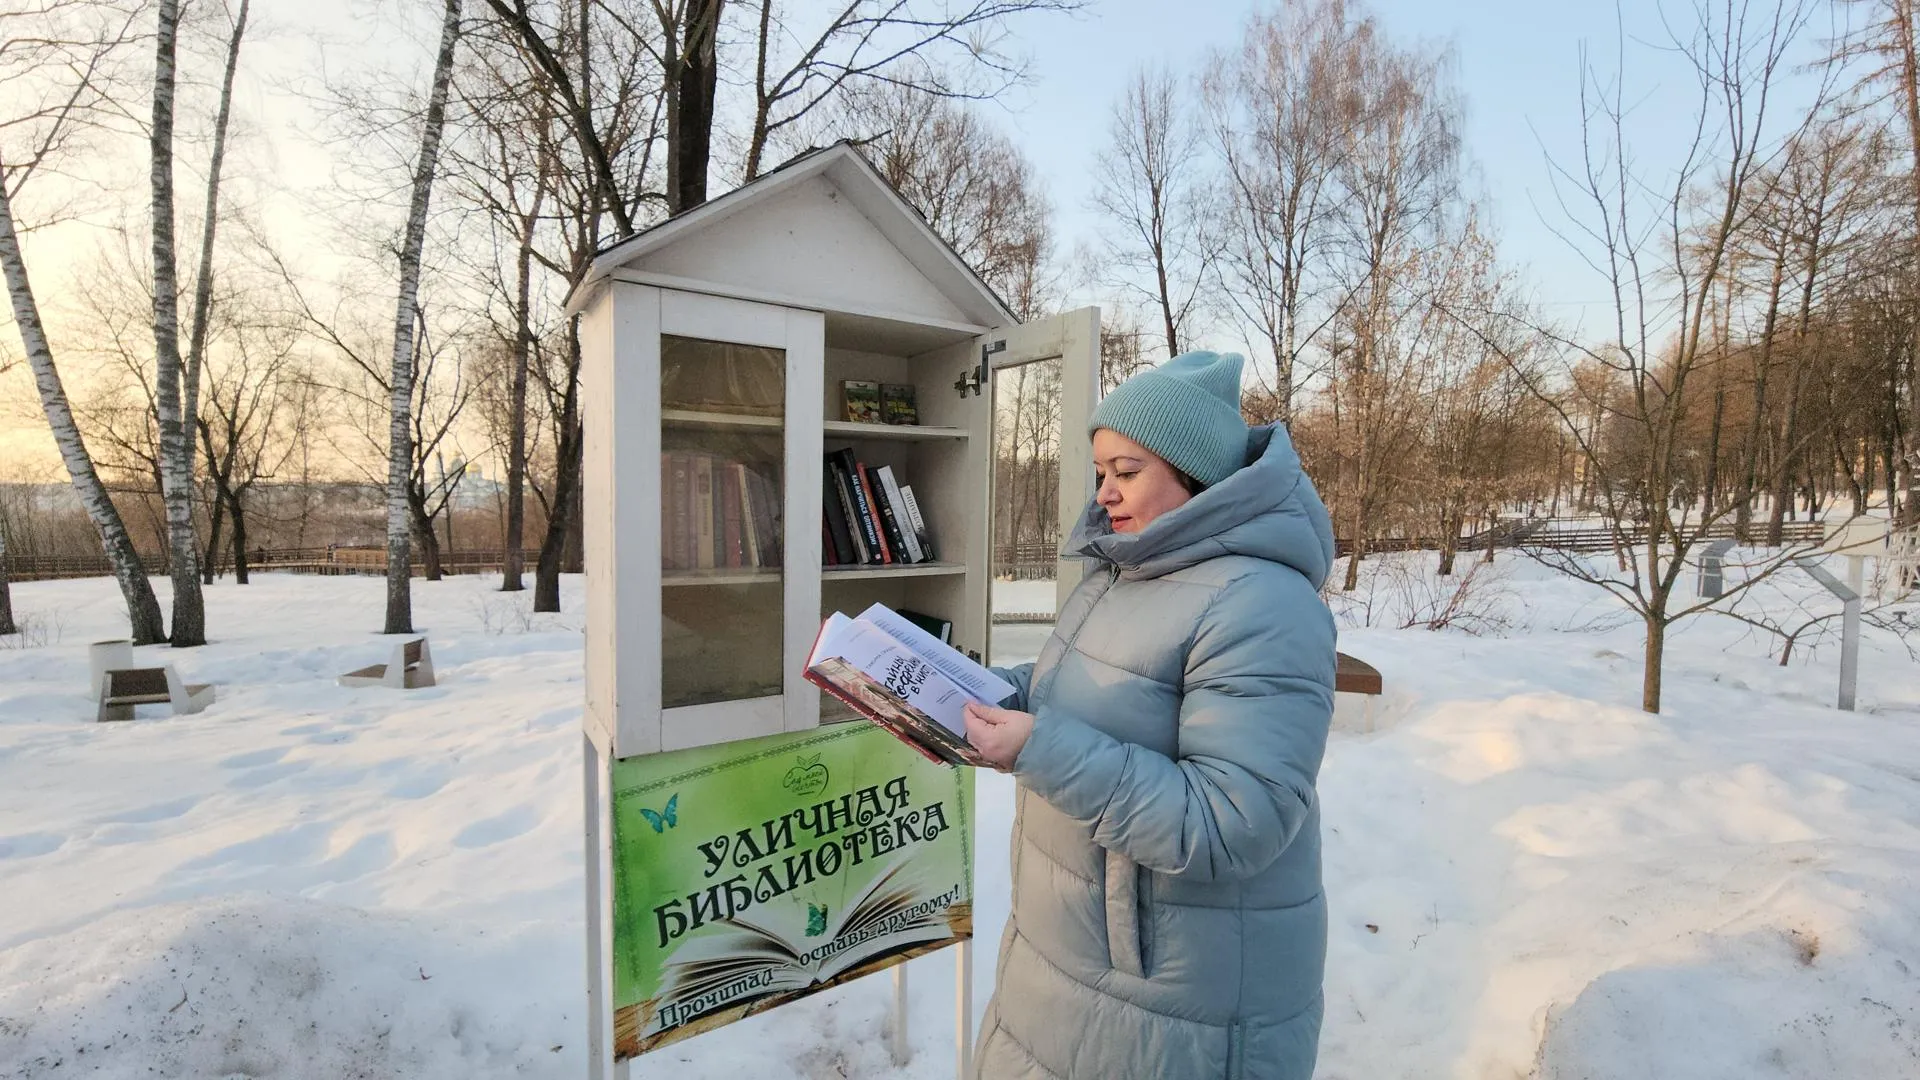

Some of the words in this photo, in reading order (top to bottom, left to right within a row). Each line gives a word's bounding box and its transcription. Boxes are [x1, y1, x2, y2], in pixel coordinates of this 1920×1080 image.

[653, 802, 950, 948] БИБЛИОТЕКА
[697, 776, 910, 878] УЛИЧНАЯ
[658, 967, 774, 1029] Прочитал
[800, 928, 869, 966] оставь
[877, 884, 960, 935] другому!
